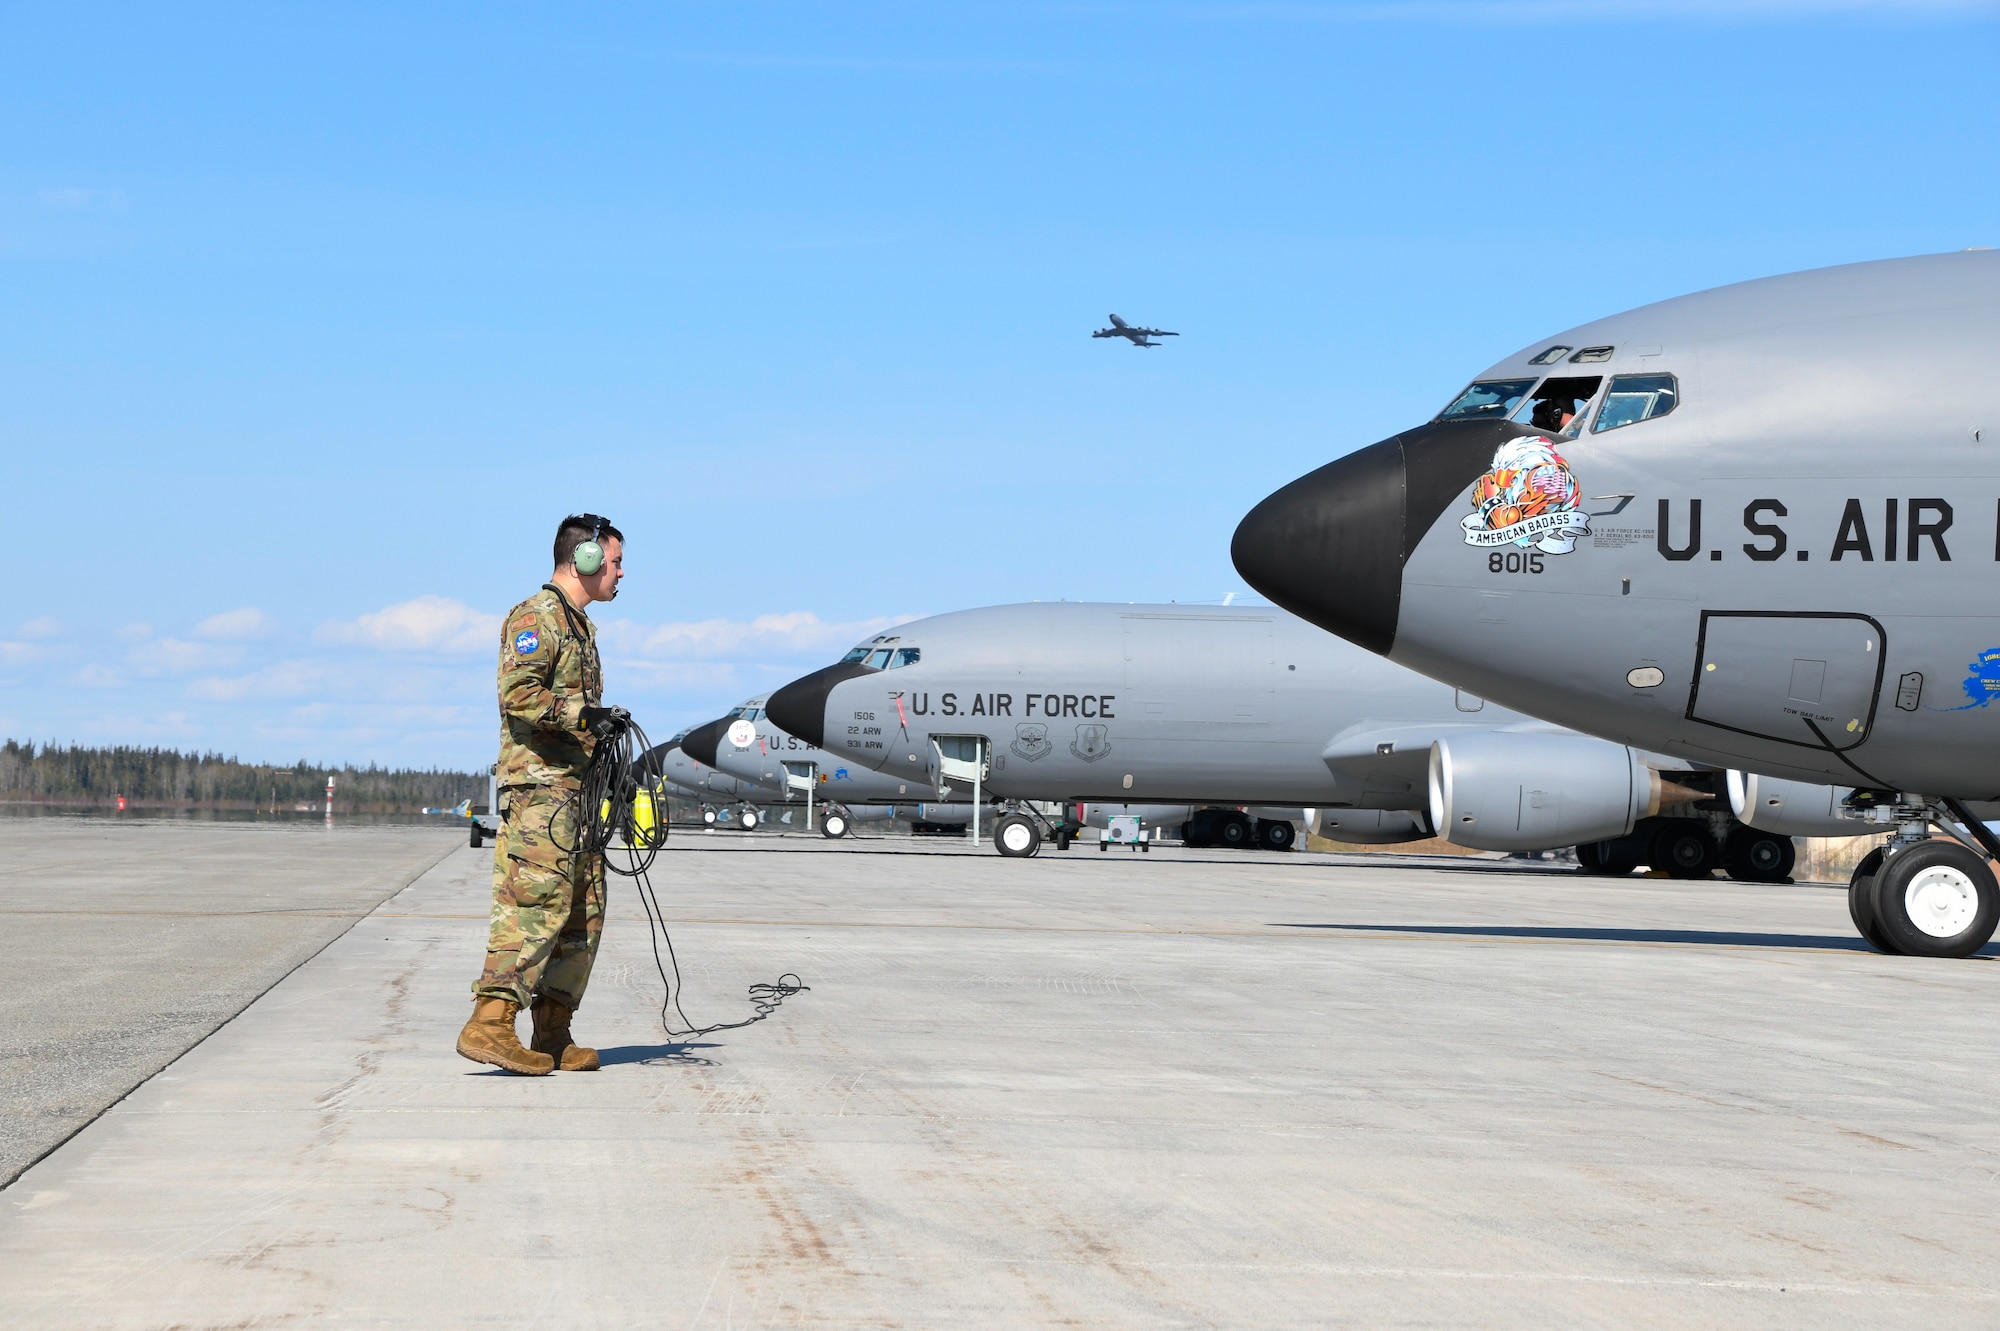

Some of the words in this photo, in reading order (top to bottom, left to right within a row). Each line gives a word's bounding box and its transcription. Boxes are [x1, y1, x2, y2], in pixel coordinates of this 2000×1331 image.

[1475, 525, 1527, 544] AMERICAN
[1528, 513, 1570, 533] BADASS
[1657, 499, 1809, 561] U.S.
[1829, 498, 1953, 561] AIR
[1488, 552, 1545, 574] 8015
[912, 692, 965, 716] U.S.
[971, 693, 1012, 716] AIR
[1026, 693, 1115, 718] FORCE
[1783, 707, 1798, 715] TOW
[1800, 711, 1814, 719] BAR
[854, 711, 875, 721] 1506
[847, 726, 860, 735] 22
[862, 727, 882, 735] ARW
[847, 739, 861, 748] 931
[864, 741, 883, 749] ARW
